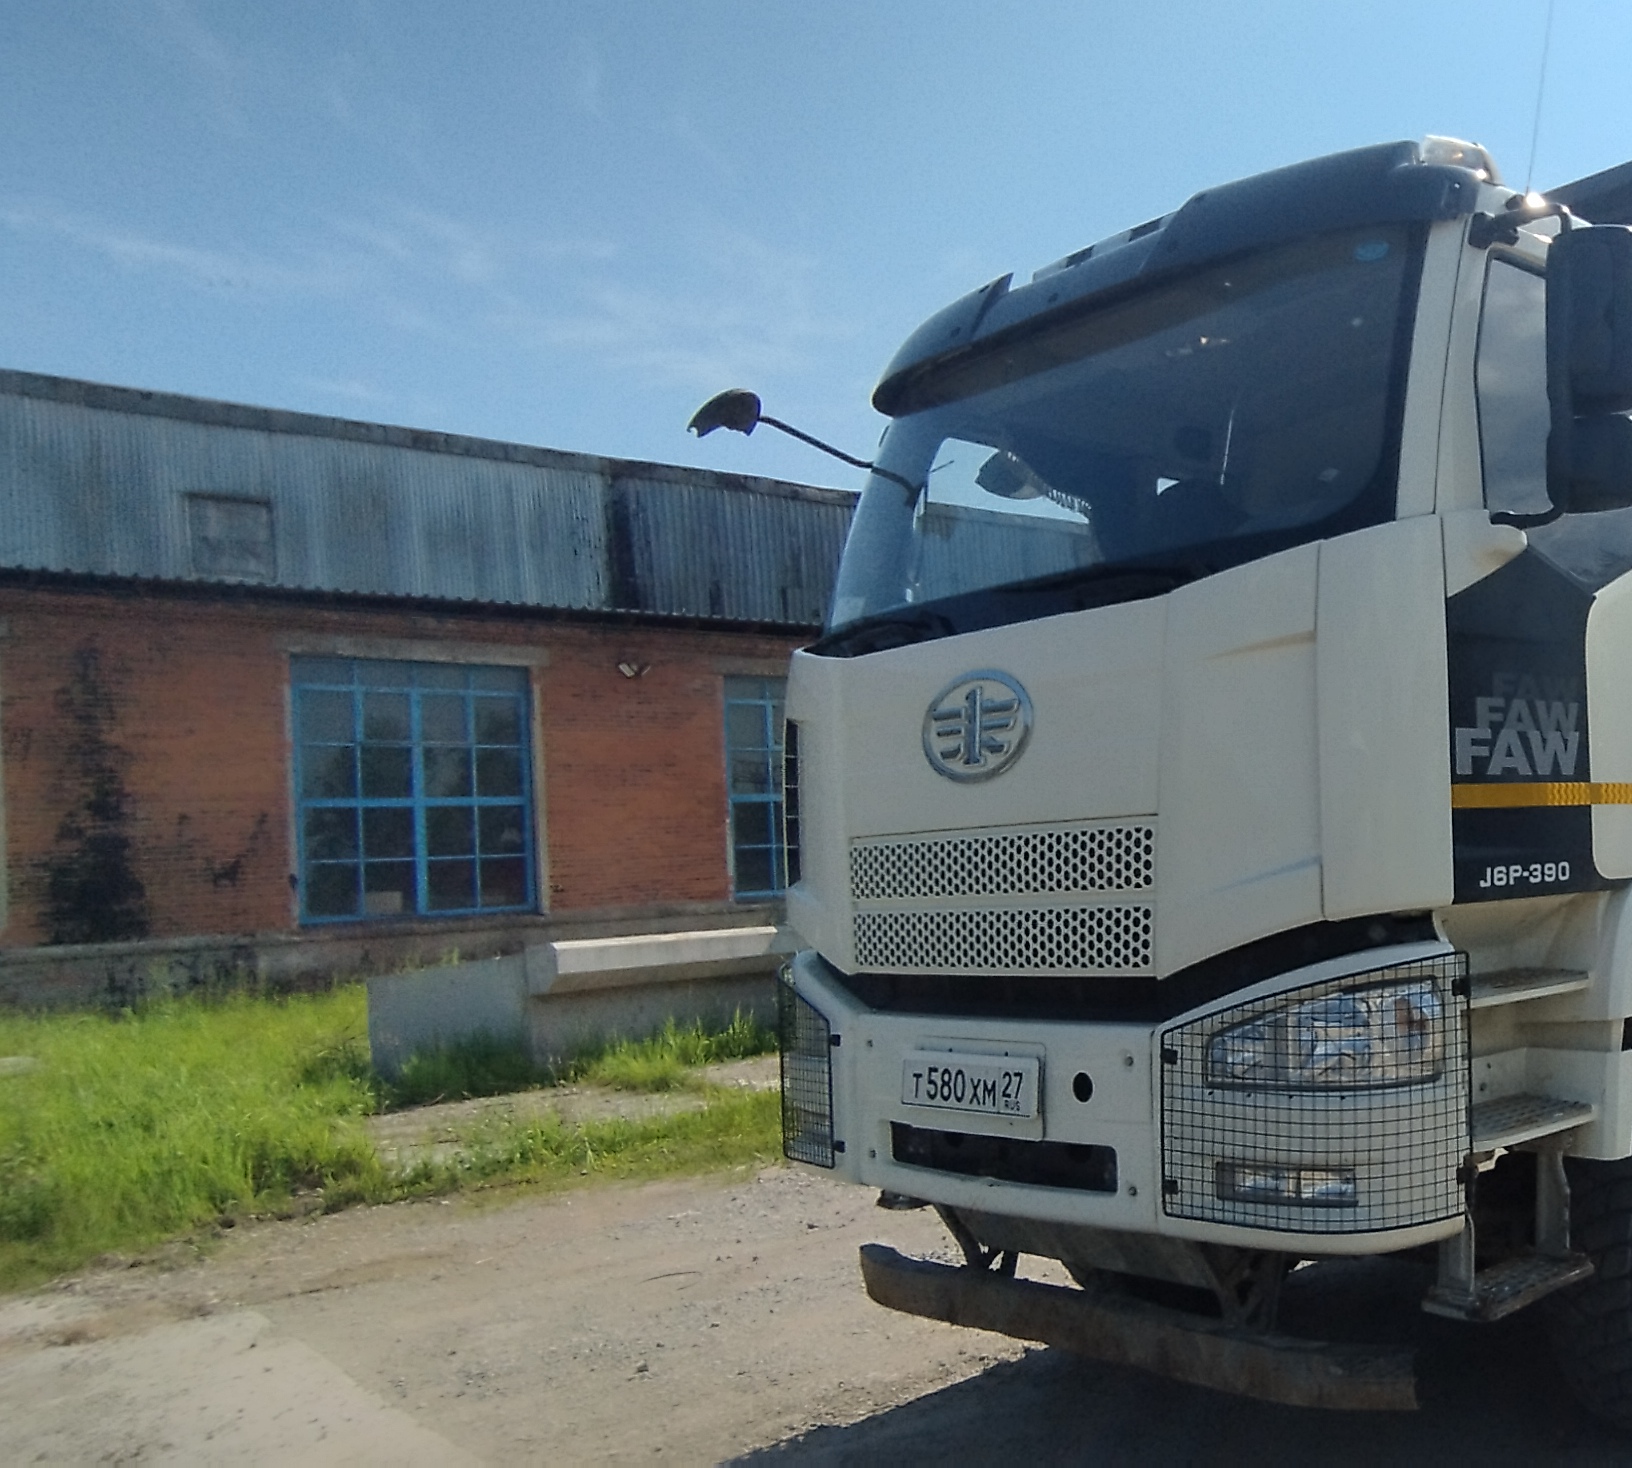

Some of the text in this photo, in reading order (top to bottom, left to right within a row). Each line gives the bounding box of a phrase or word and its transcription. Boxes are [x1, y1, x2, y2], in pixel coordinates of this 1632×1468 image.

[1476, 696, 1579, 735] FAW
[1455, 727, 1580, 775] FAW
[1479, 861, 1571, 888] J6P-390
[1001, 1071, 1023, 1100] 27
[1004, 1101, 1021, 1112] RUS
